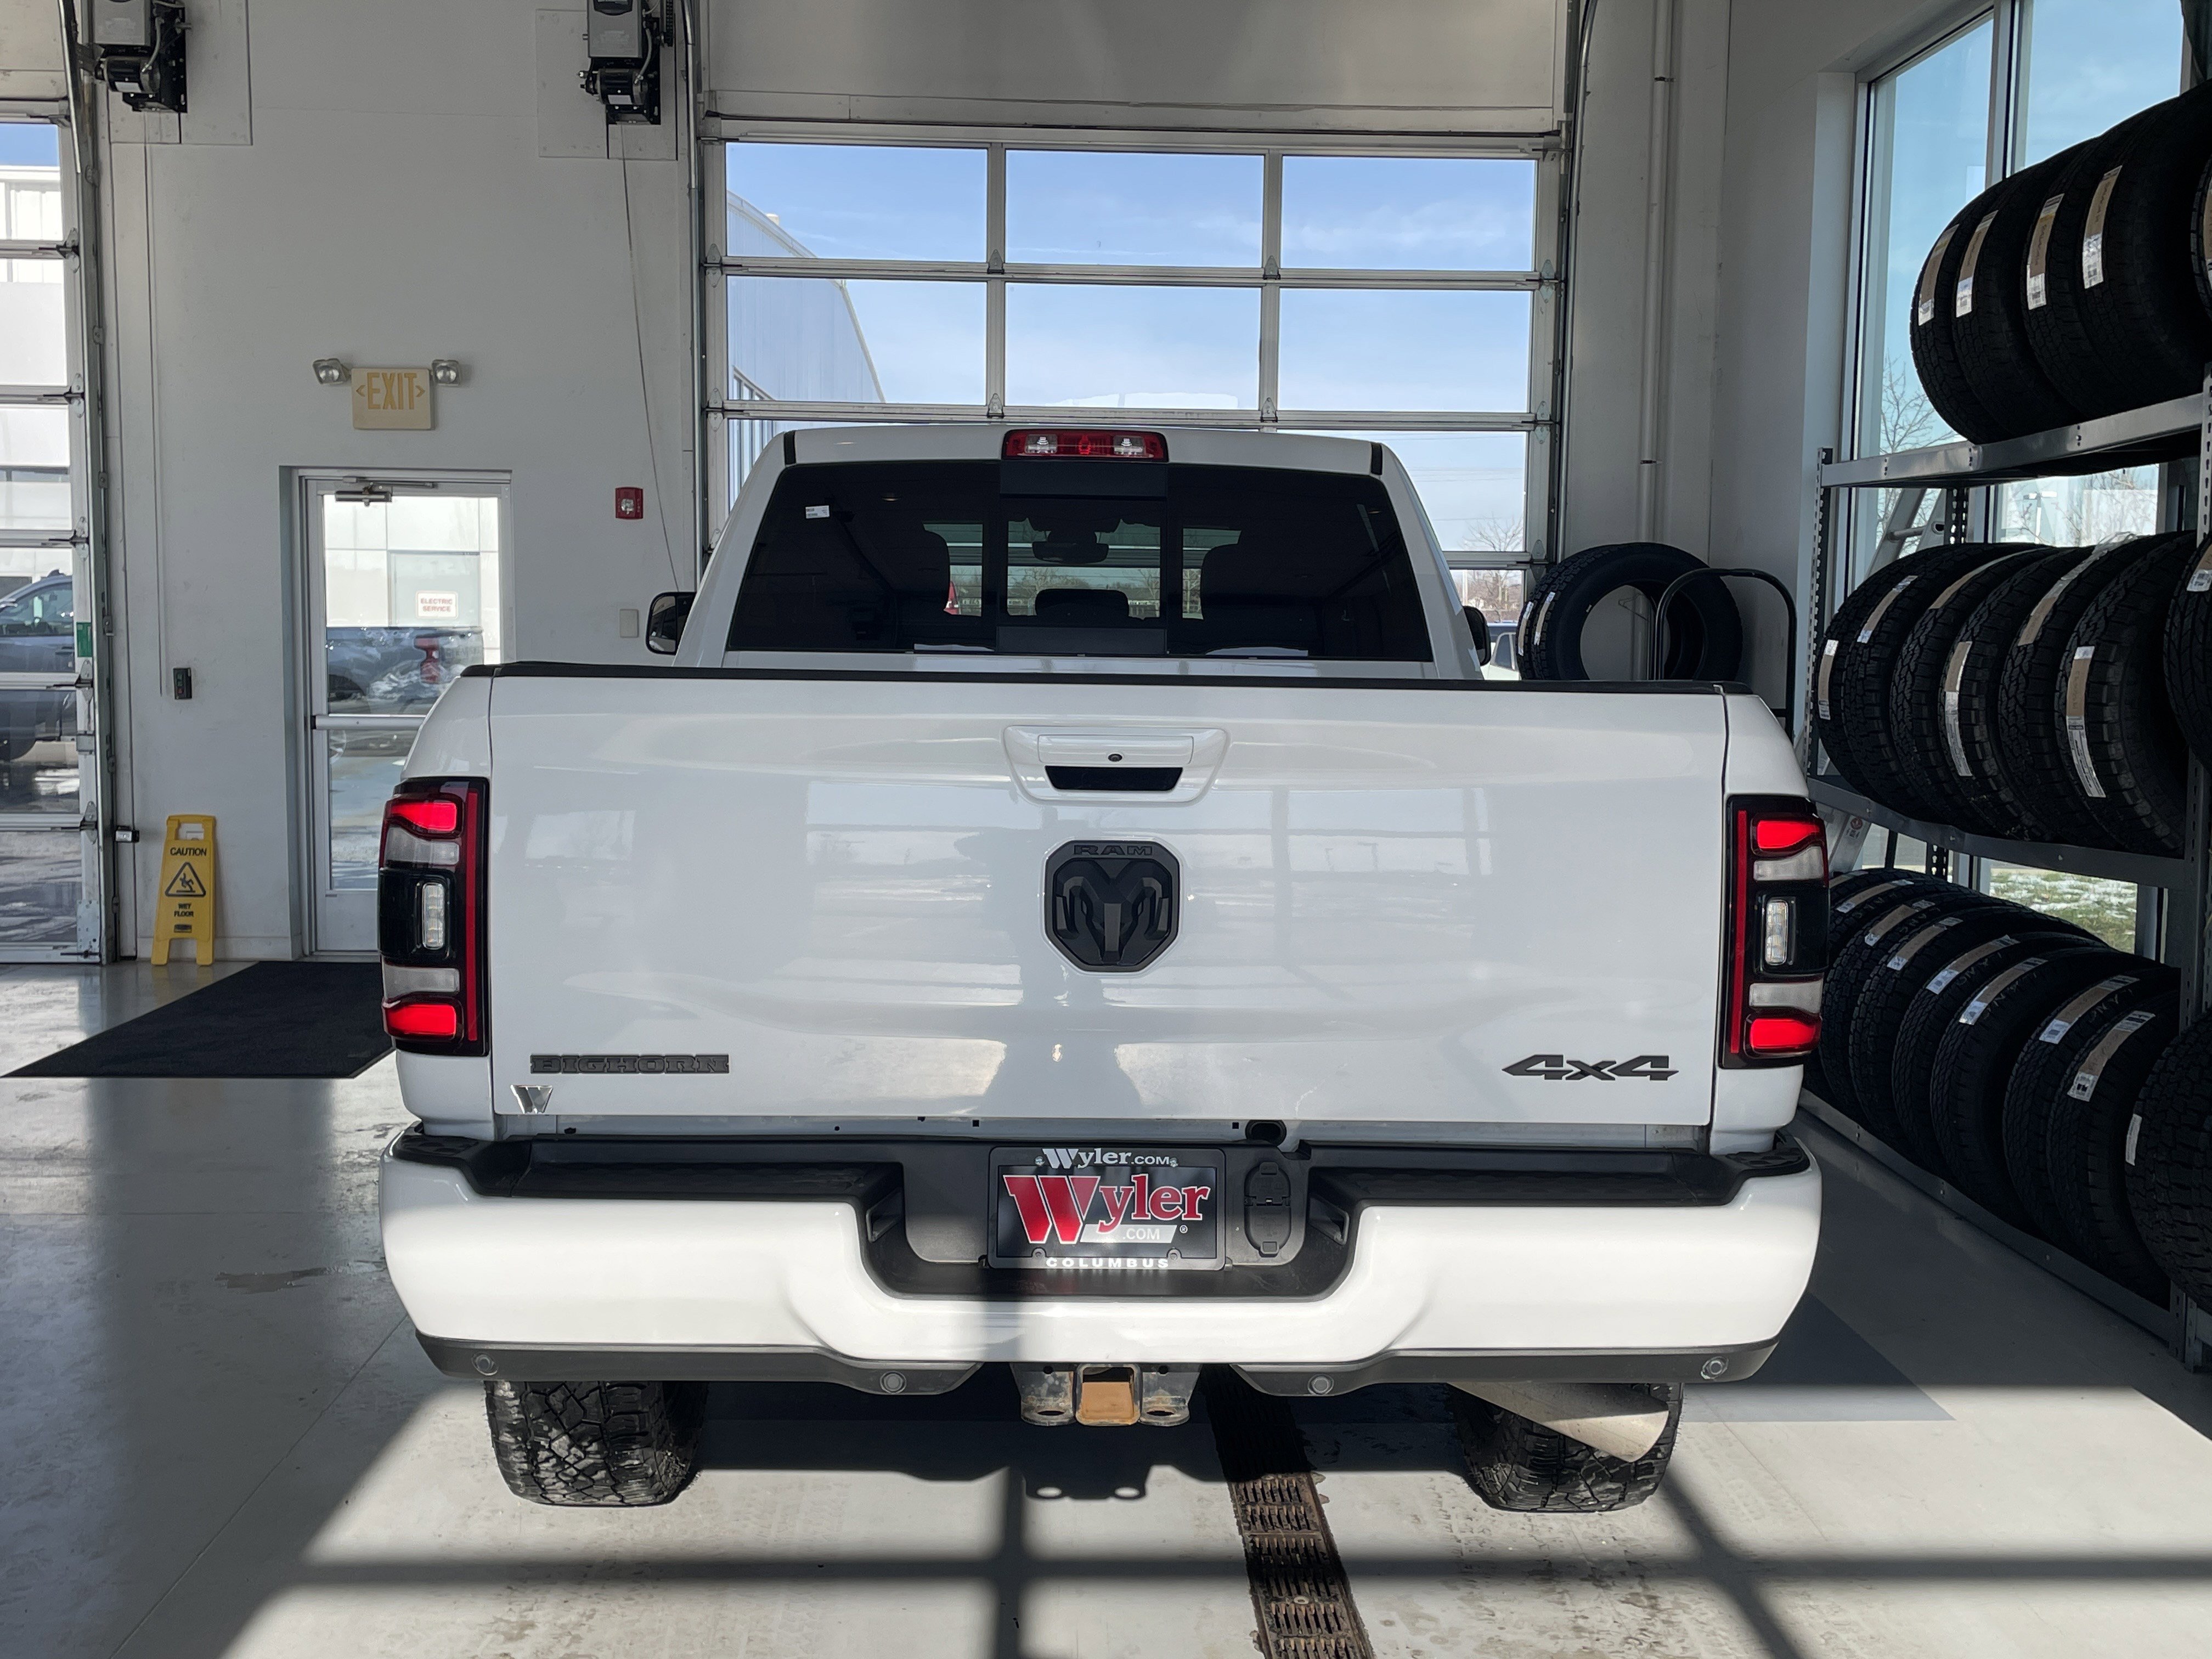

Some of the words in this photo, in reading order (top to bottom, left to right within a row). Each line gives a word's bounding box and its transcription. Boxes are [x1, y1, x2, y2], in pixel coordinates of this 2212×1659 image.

[367, 372, 416, 410] EXIT
[170, 847, 207, 856] CAUTION
[1074, 845, 1153, 855] RAM
[530, 1054, 730, 1074] BIGHORN
[1003, 1173, 1211, 1244] Wyler
[1046, 1257, 1170, 1268] COLUMBUS
